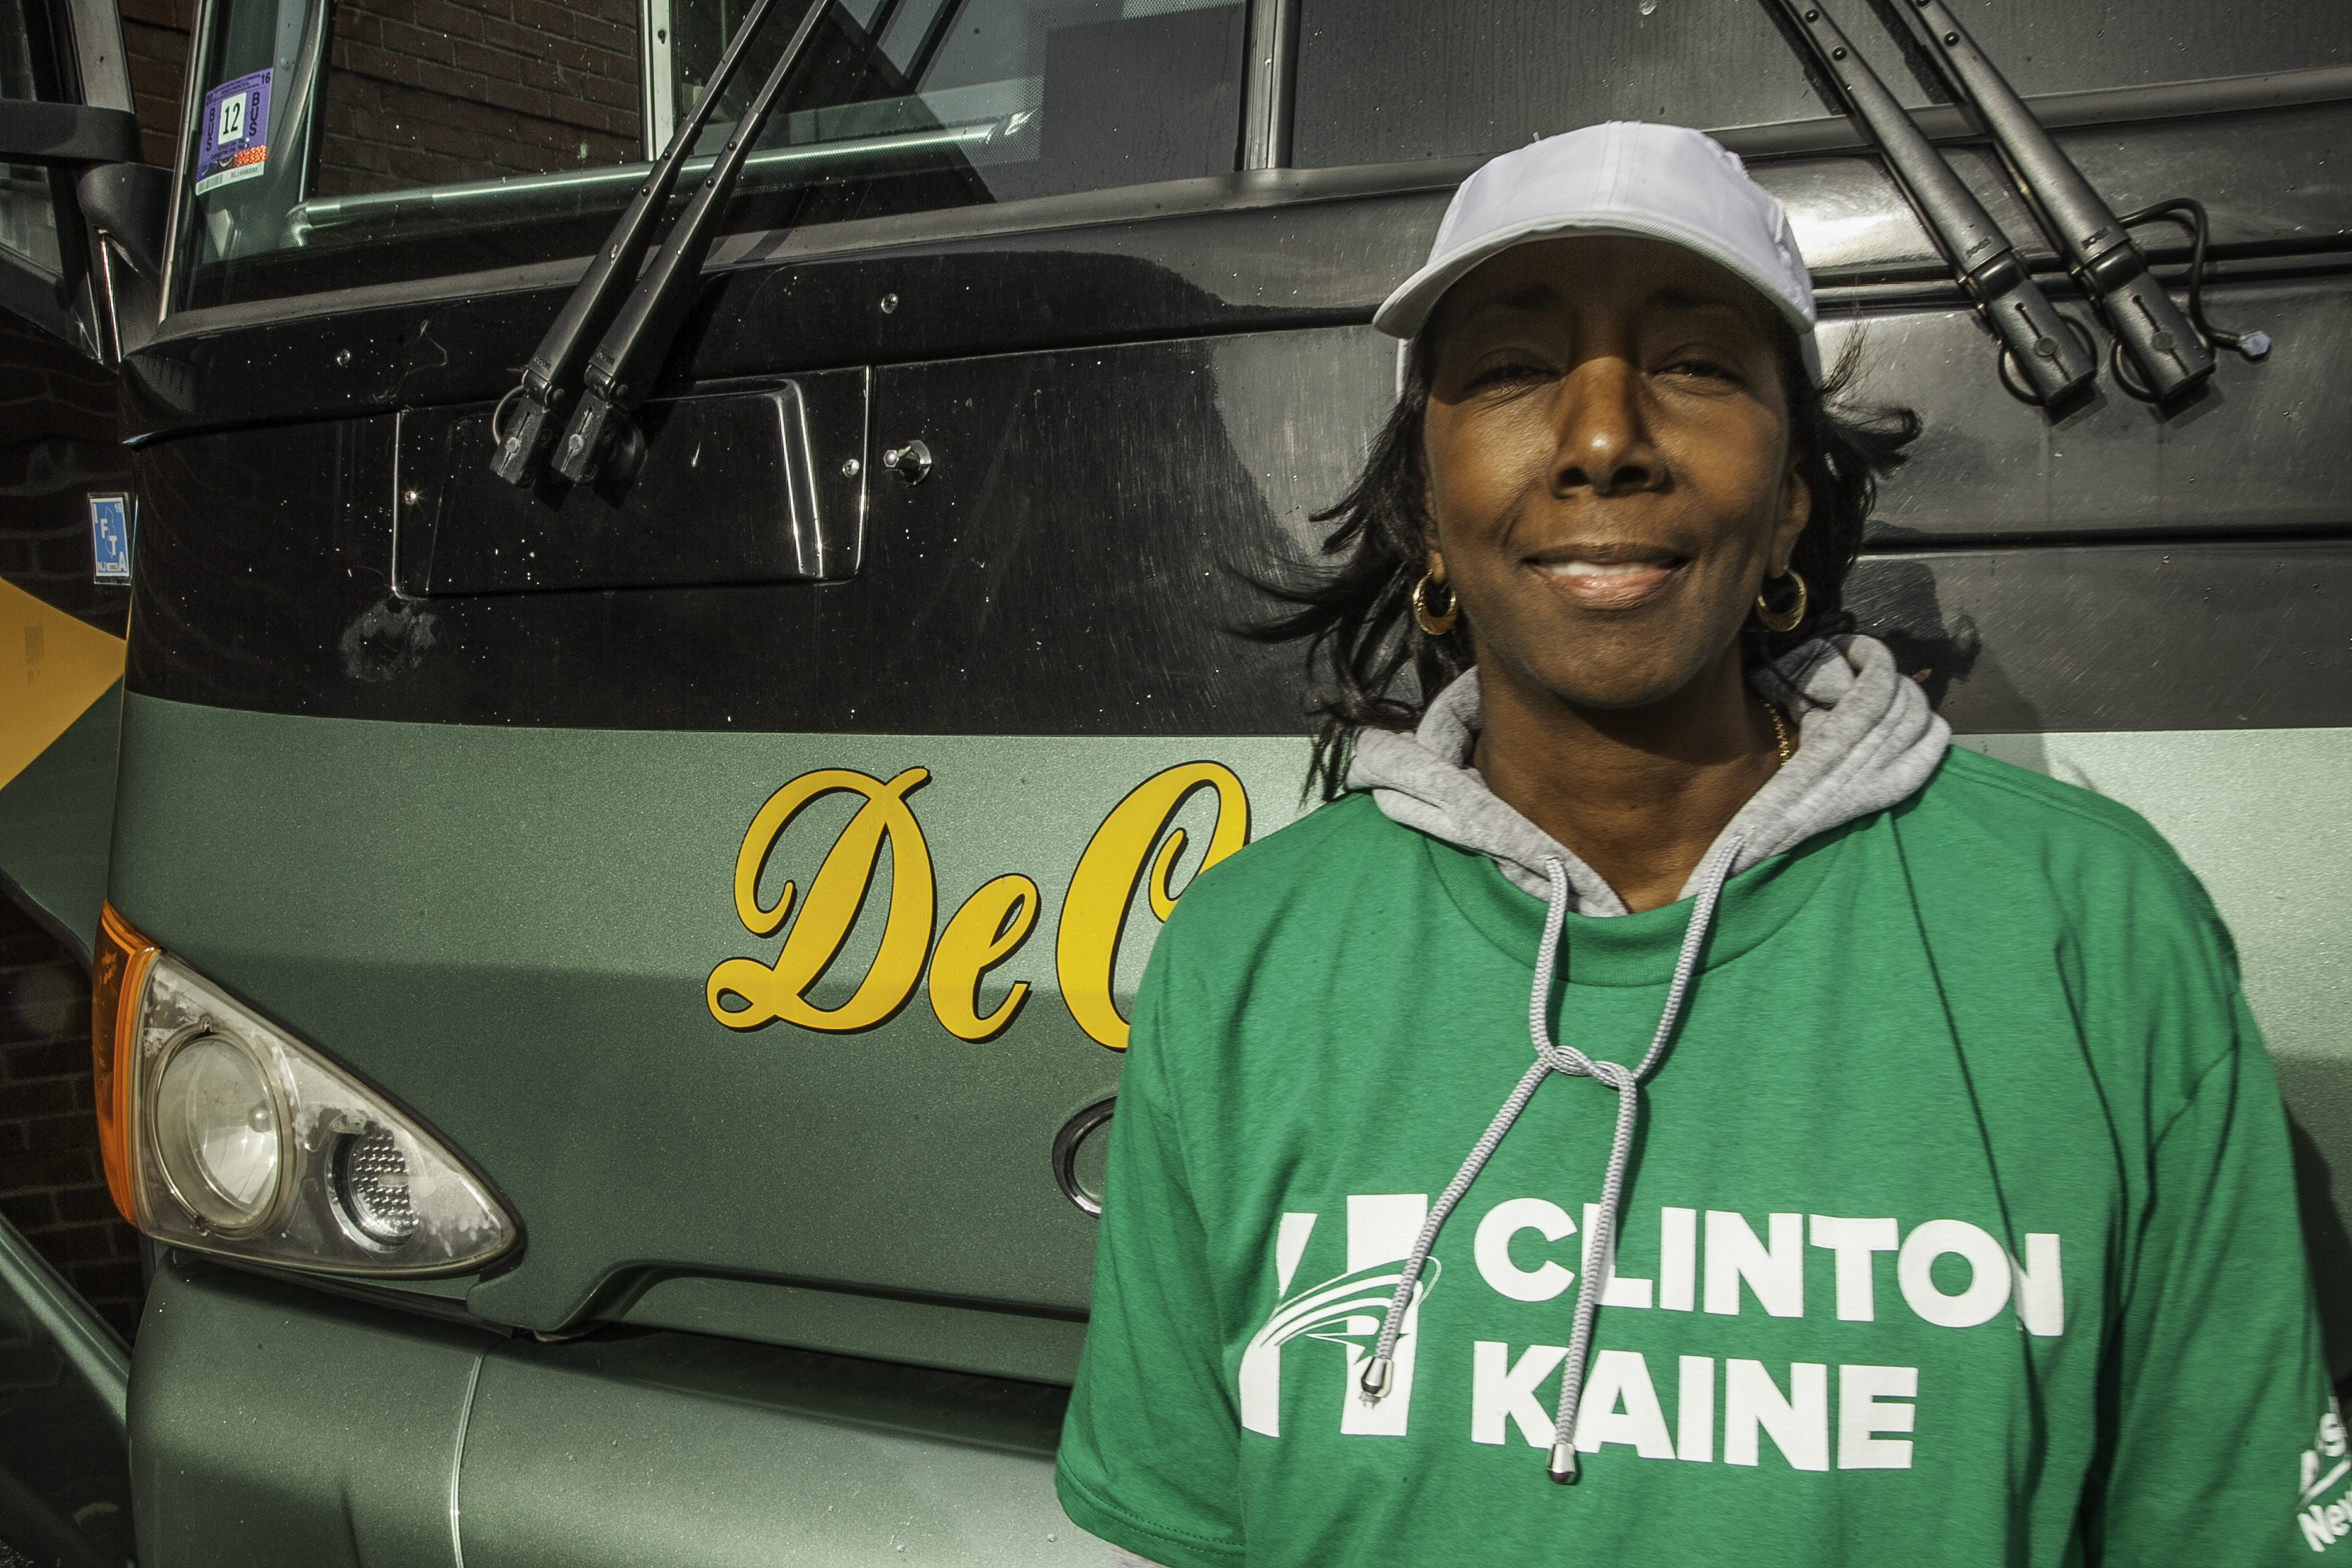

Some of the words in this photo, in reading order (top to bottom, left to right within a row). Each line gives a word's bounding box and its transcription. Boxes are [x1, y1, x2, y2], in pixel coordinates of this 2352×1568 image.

[261, 72, 271, 85] 16
[206, 107, 215, 152] BUS
[223, 102, 241, 135] 12
[249, 91, 260, 136] BUS
[114, 503, 122, 514] 16
[97, 561, 107, 571] NJ
[1473, 1197, 2064, 1336] CLINTON
[1471, 1340, 1918, 1471] KAINE
